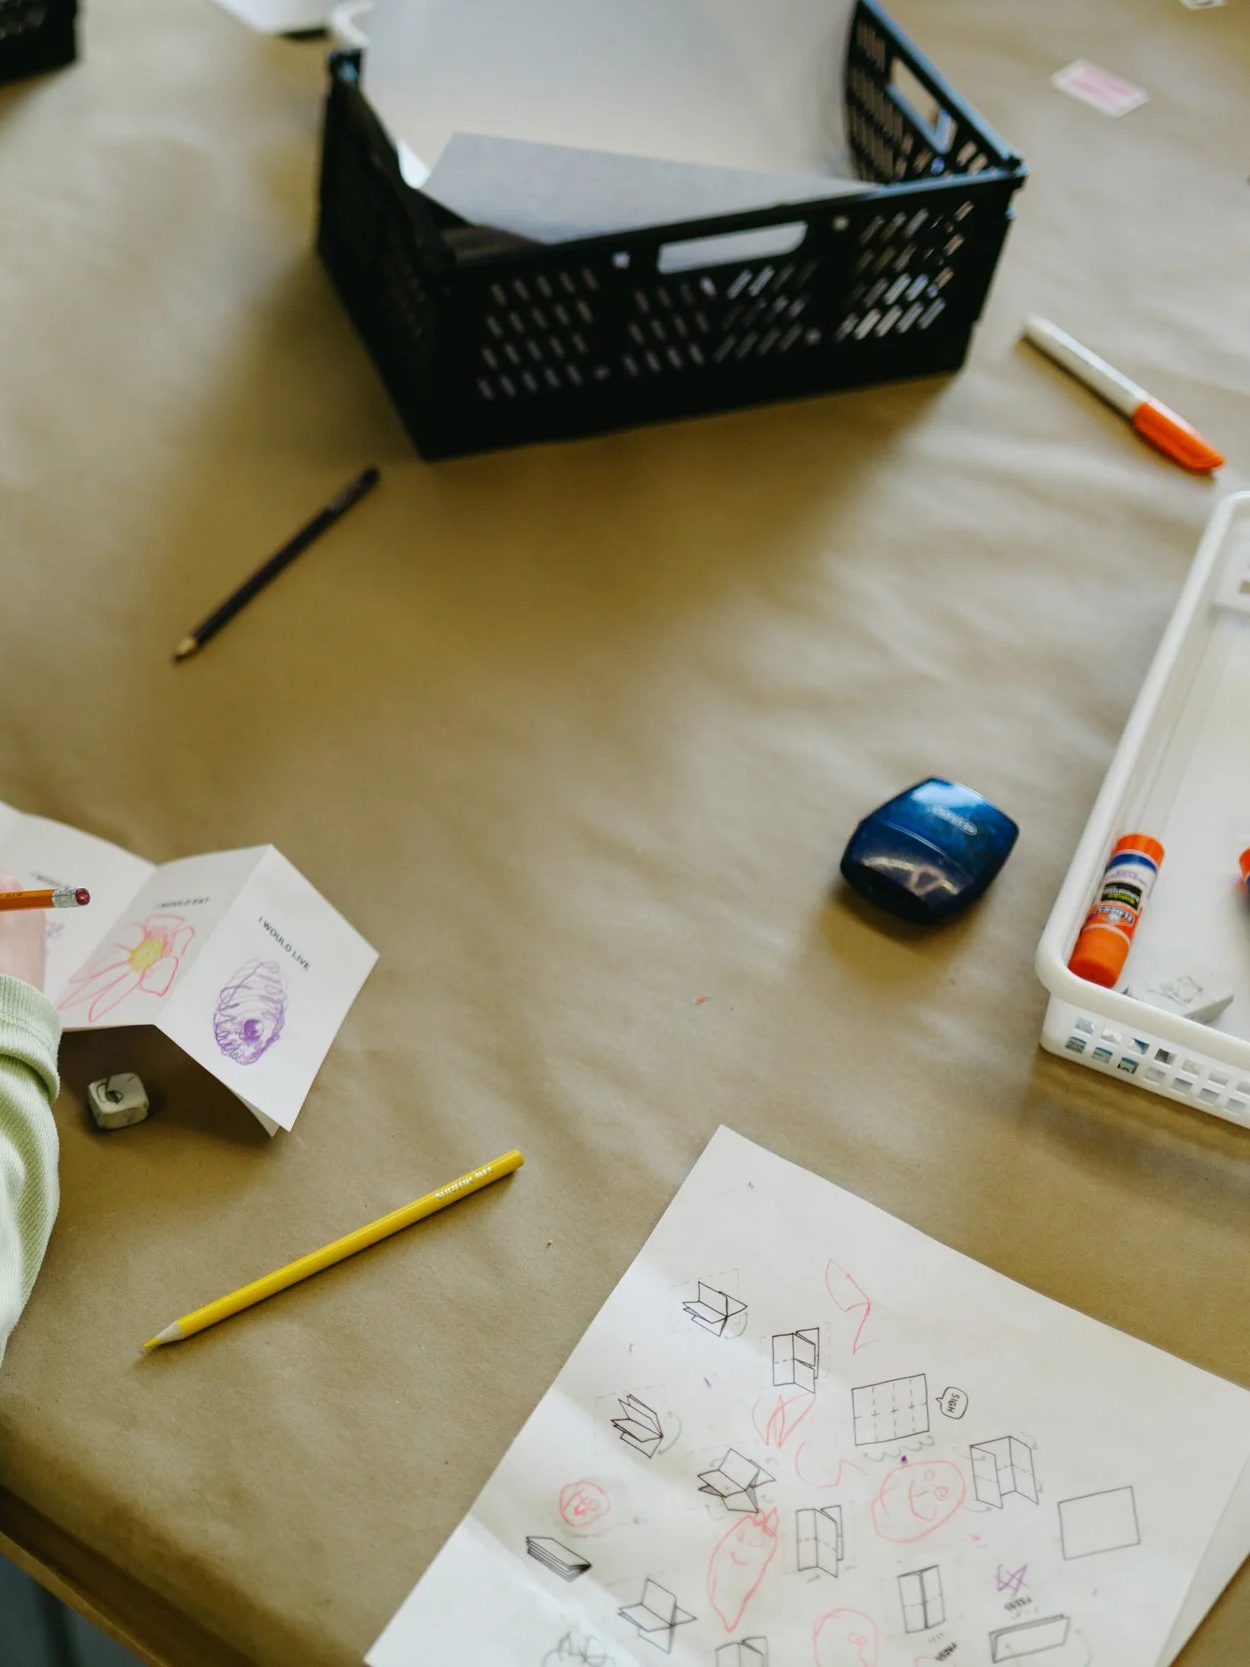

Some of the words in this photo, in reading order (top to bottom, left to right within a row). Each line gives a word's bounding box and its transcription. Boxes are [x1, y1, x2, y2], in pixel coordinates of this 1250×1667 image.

[161, 898, 191, 909] WOULD
[263, 920, 292, 953] WOULD
[291, 951, 310, 970] LIVE
[946, 1392, 960, 1414] SIGH
